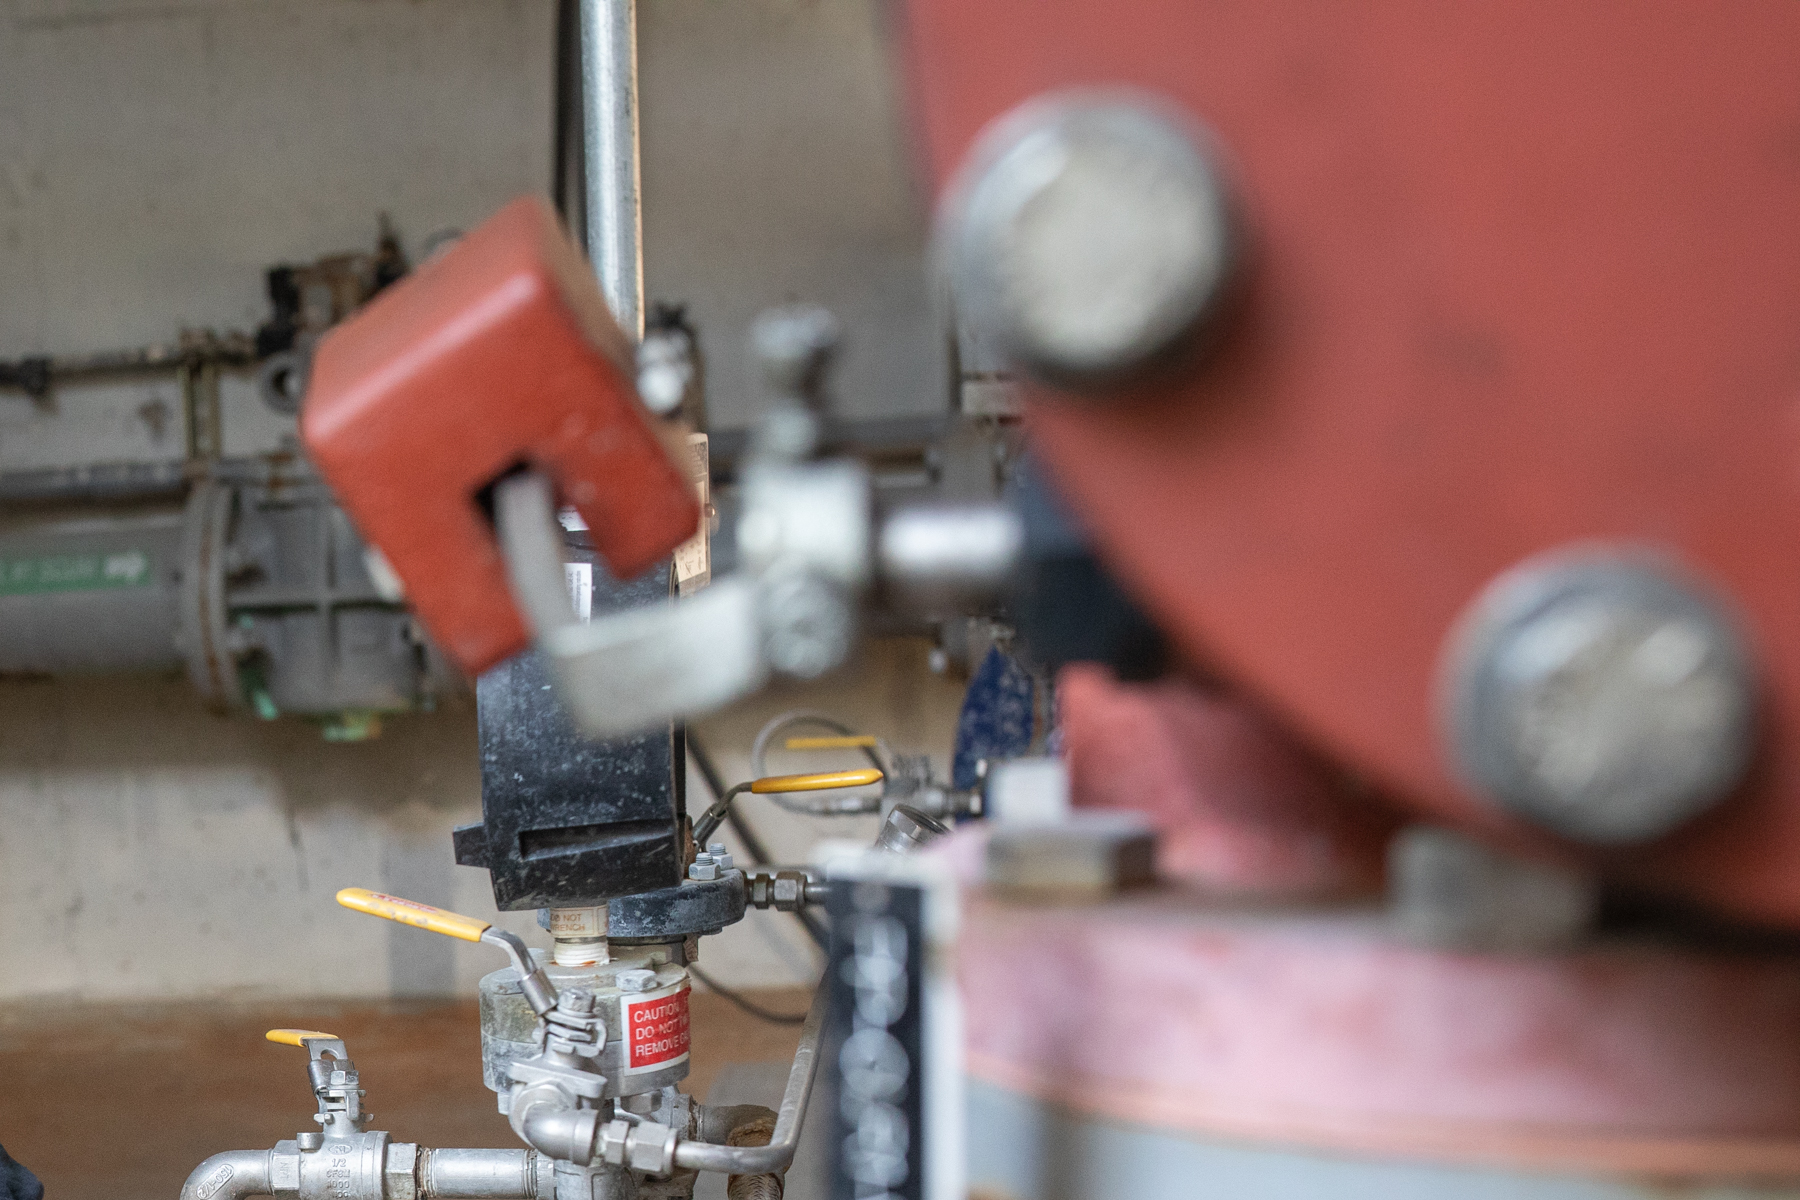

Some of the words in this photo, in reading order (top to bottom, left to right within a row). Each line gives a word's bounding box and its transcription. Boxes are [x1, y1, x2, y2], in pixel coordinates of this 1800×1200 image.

[563, 913, 582, 922] NOT
[633, 1002, 680, 1023] CAUTION
[635, 1025, 655, 1041] DO
[658, 1018, 678, 1034] NOT
[635, 1033, 680, 1058] REMOVE
[332, 1158, 347, 1168] 1/2
